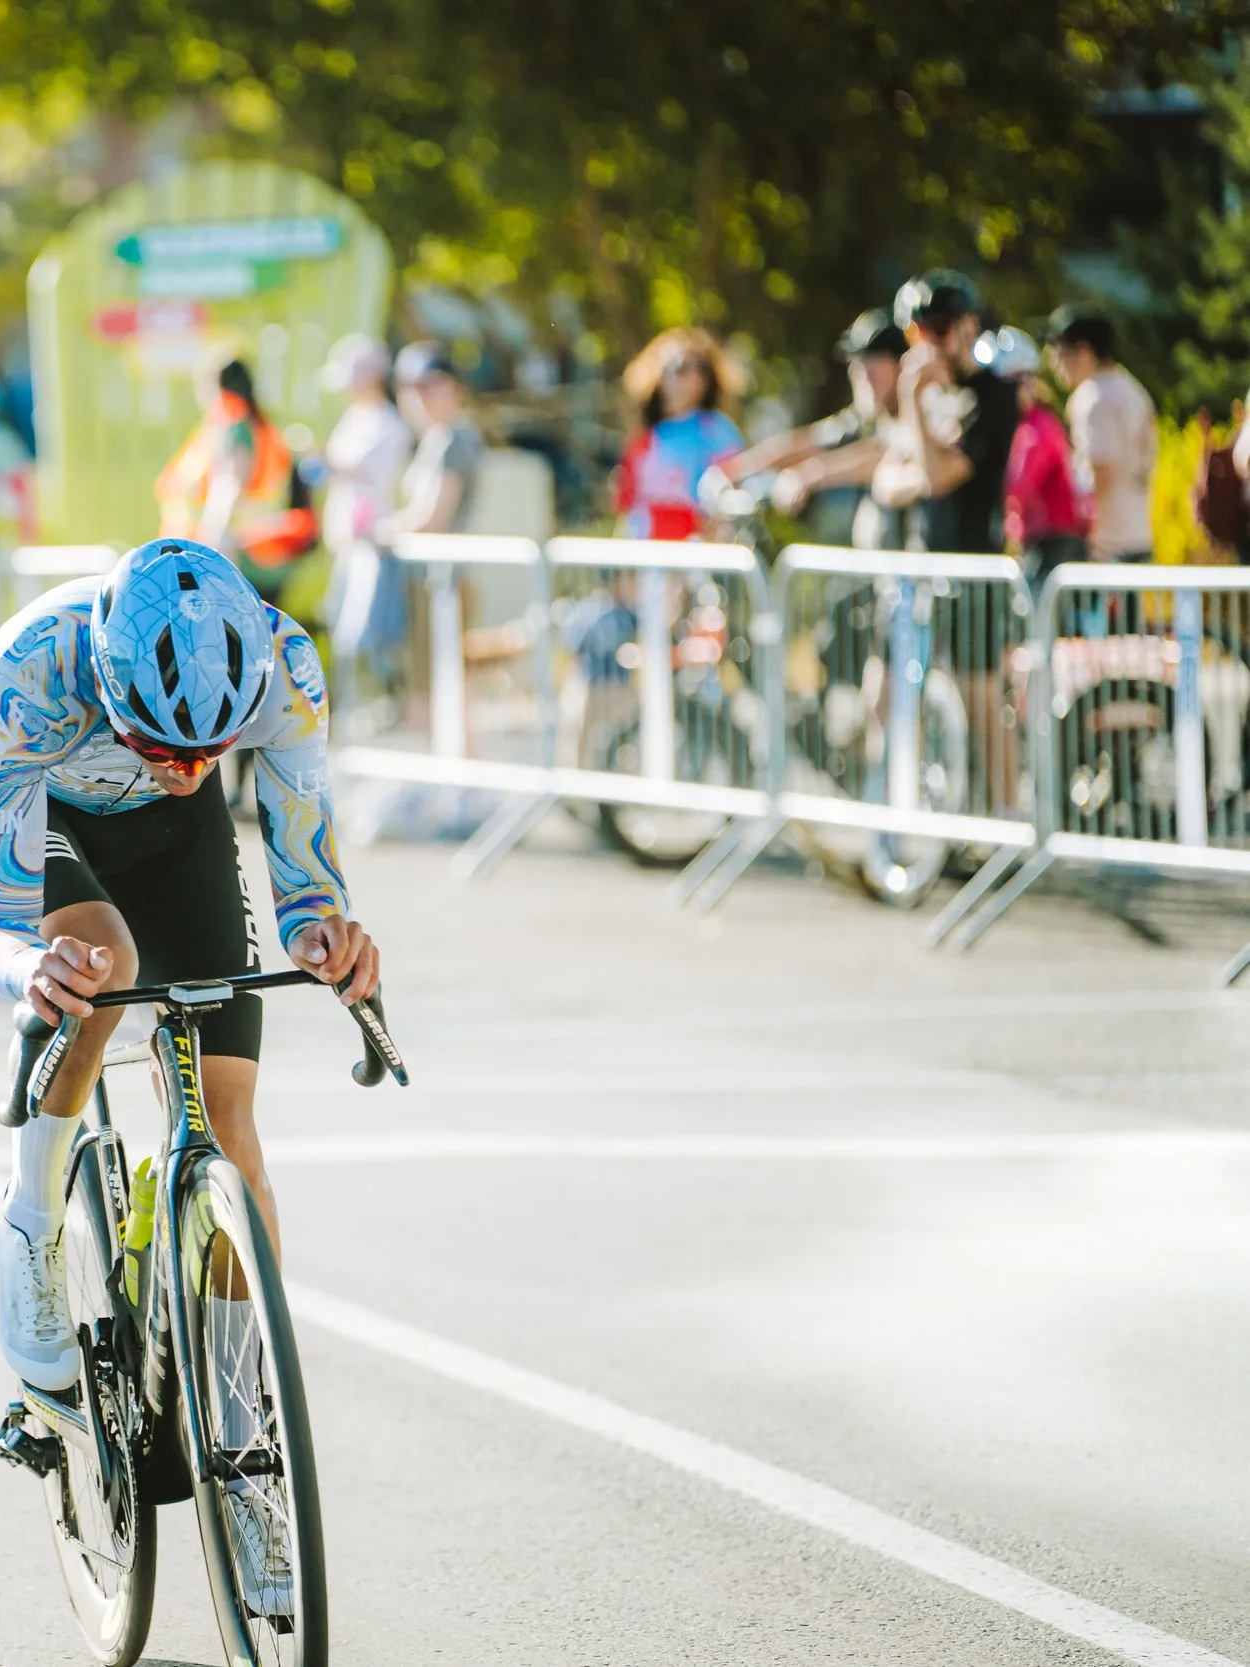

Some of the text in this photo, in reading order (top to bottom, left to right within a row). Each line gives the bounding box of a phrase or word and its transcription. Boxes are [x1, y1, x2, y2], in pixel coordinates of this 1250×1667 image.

[96, 631, 125, 700] GIRO
[33, 1034, 67, 1101] SRAM
[359, 1008, 402, 1066] SRAM
[174, 1036, 205, 1133] FACTOR
